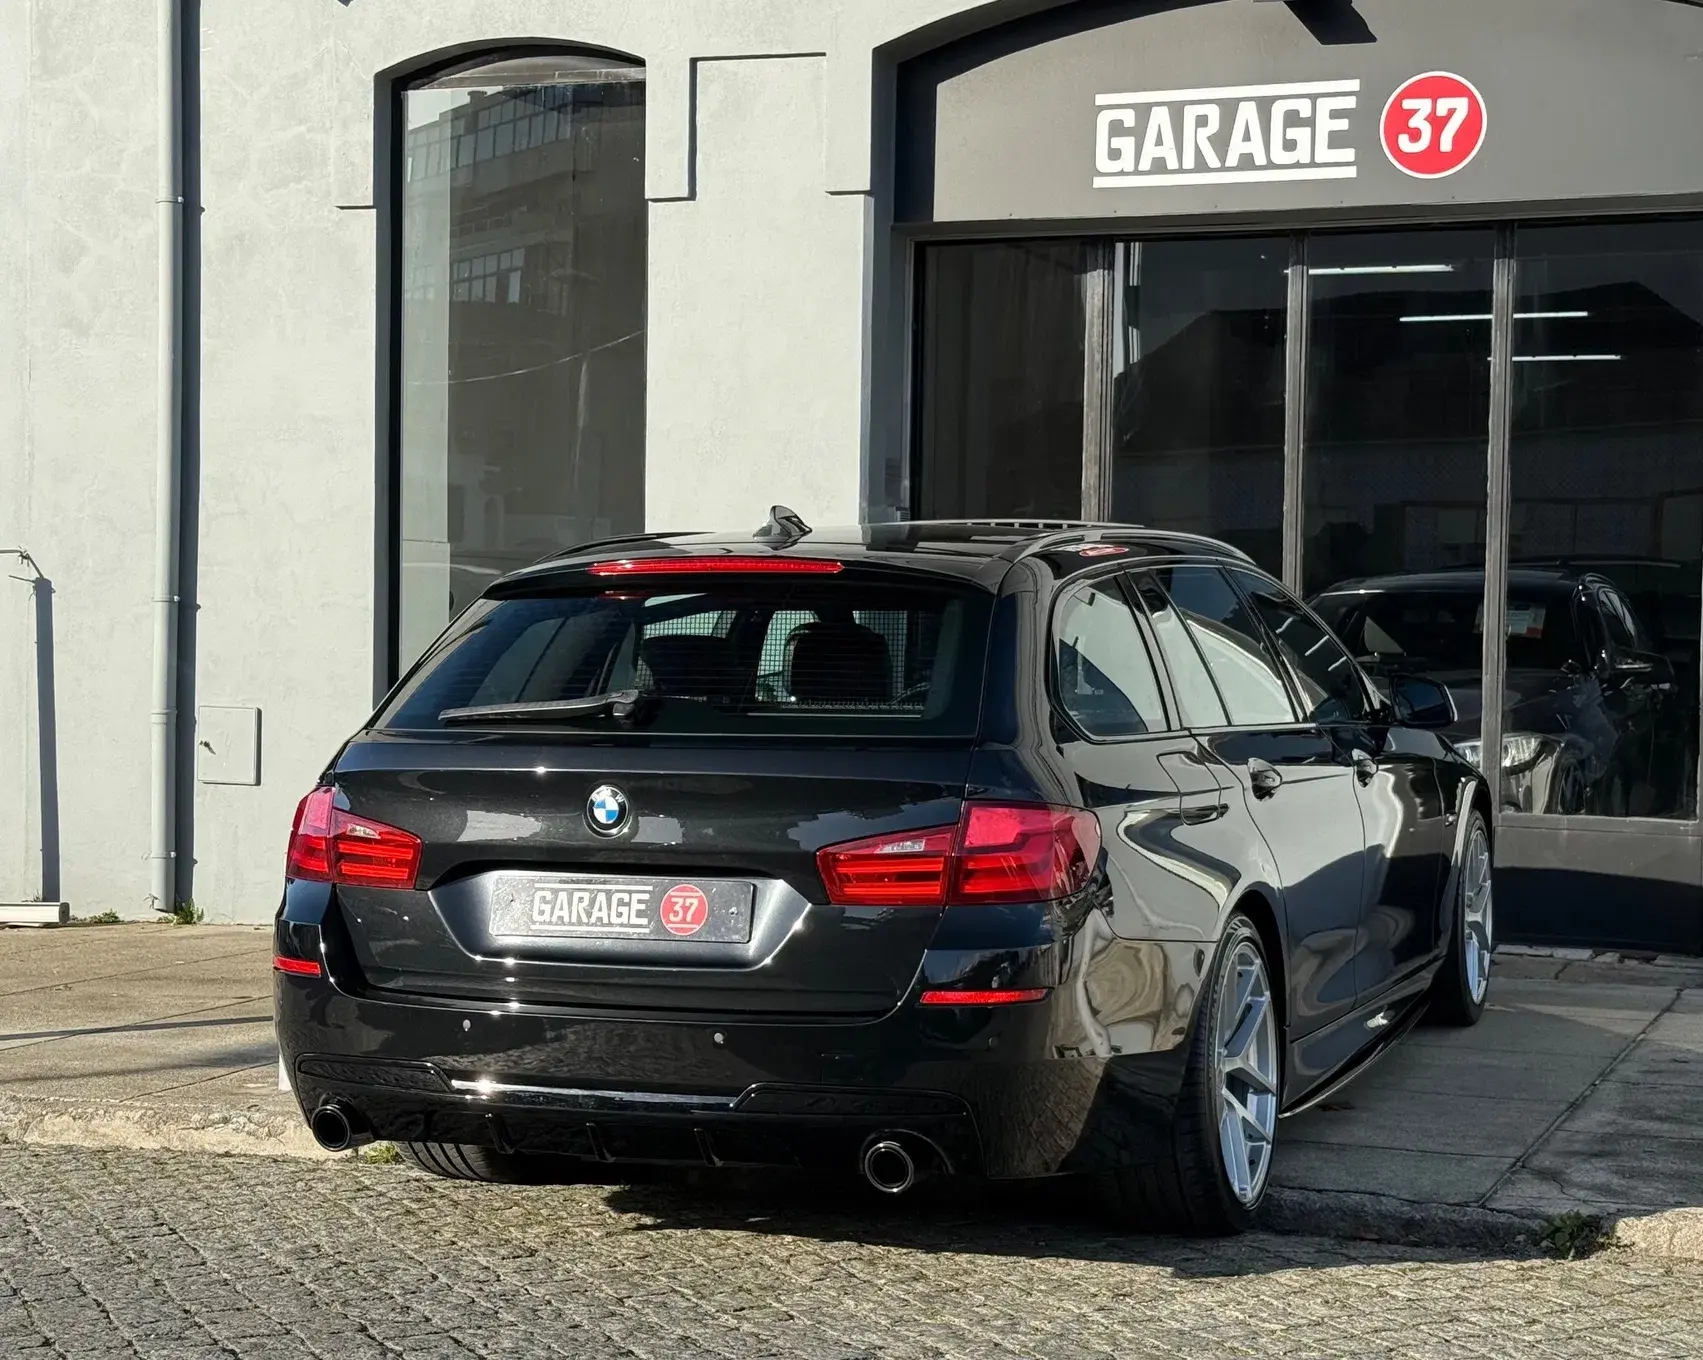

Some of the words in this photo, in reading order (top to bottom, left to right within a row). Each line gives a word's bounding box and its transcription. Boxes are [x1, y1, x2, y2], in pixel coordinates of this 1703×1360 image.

[1095, 96, 1357, 173] GARAGE
[1398, 97, 1469, 153] 37
[532, 890, 650, 925] GARAGE
[668, 897, 699, 922] 37
